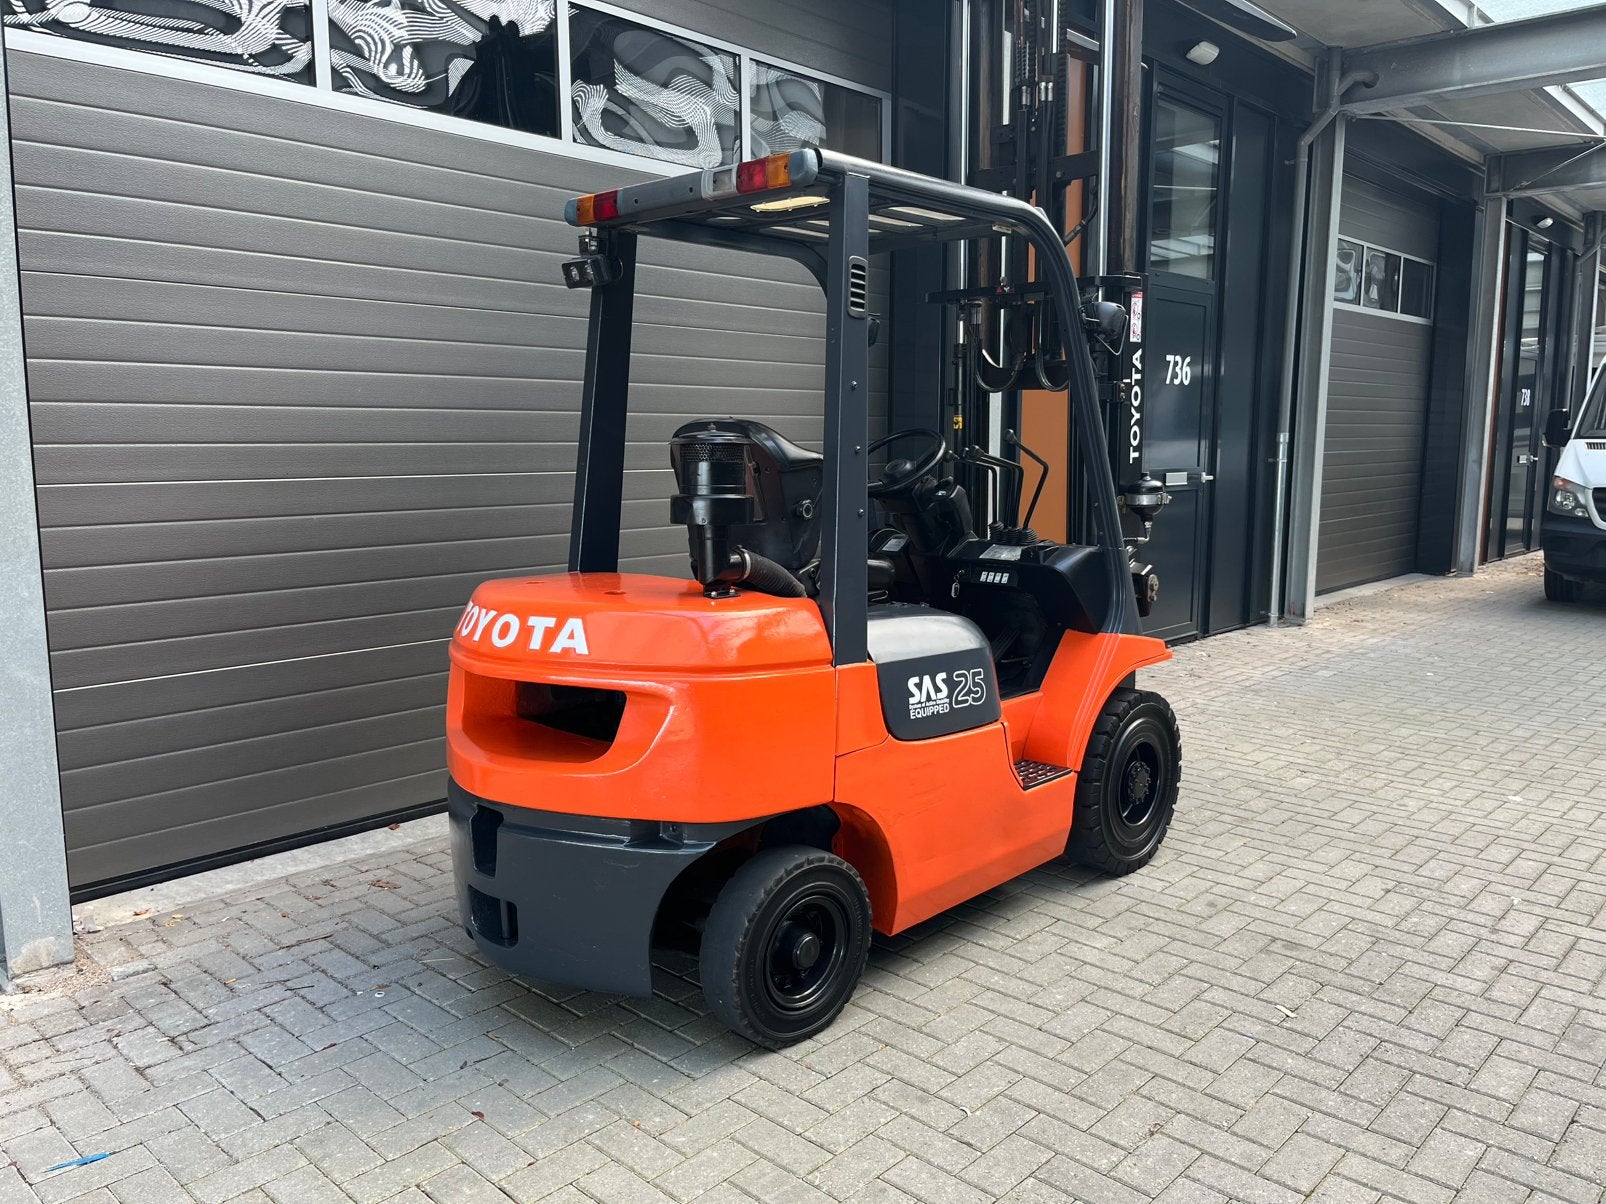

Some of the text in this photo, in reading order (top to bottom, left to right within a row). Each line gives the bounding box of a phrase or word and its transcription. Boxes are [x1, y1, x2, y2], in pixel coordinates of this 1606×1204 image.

[1165, 354, 1192, 386] 736
[1129, 348, 1143, 464] TOYOTA
[907, 671, 949, 705] SAS
[952, 668, 987, 708] 25
[909, 703, 950, 720] EQUIPPED
